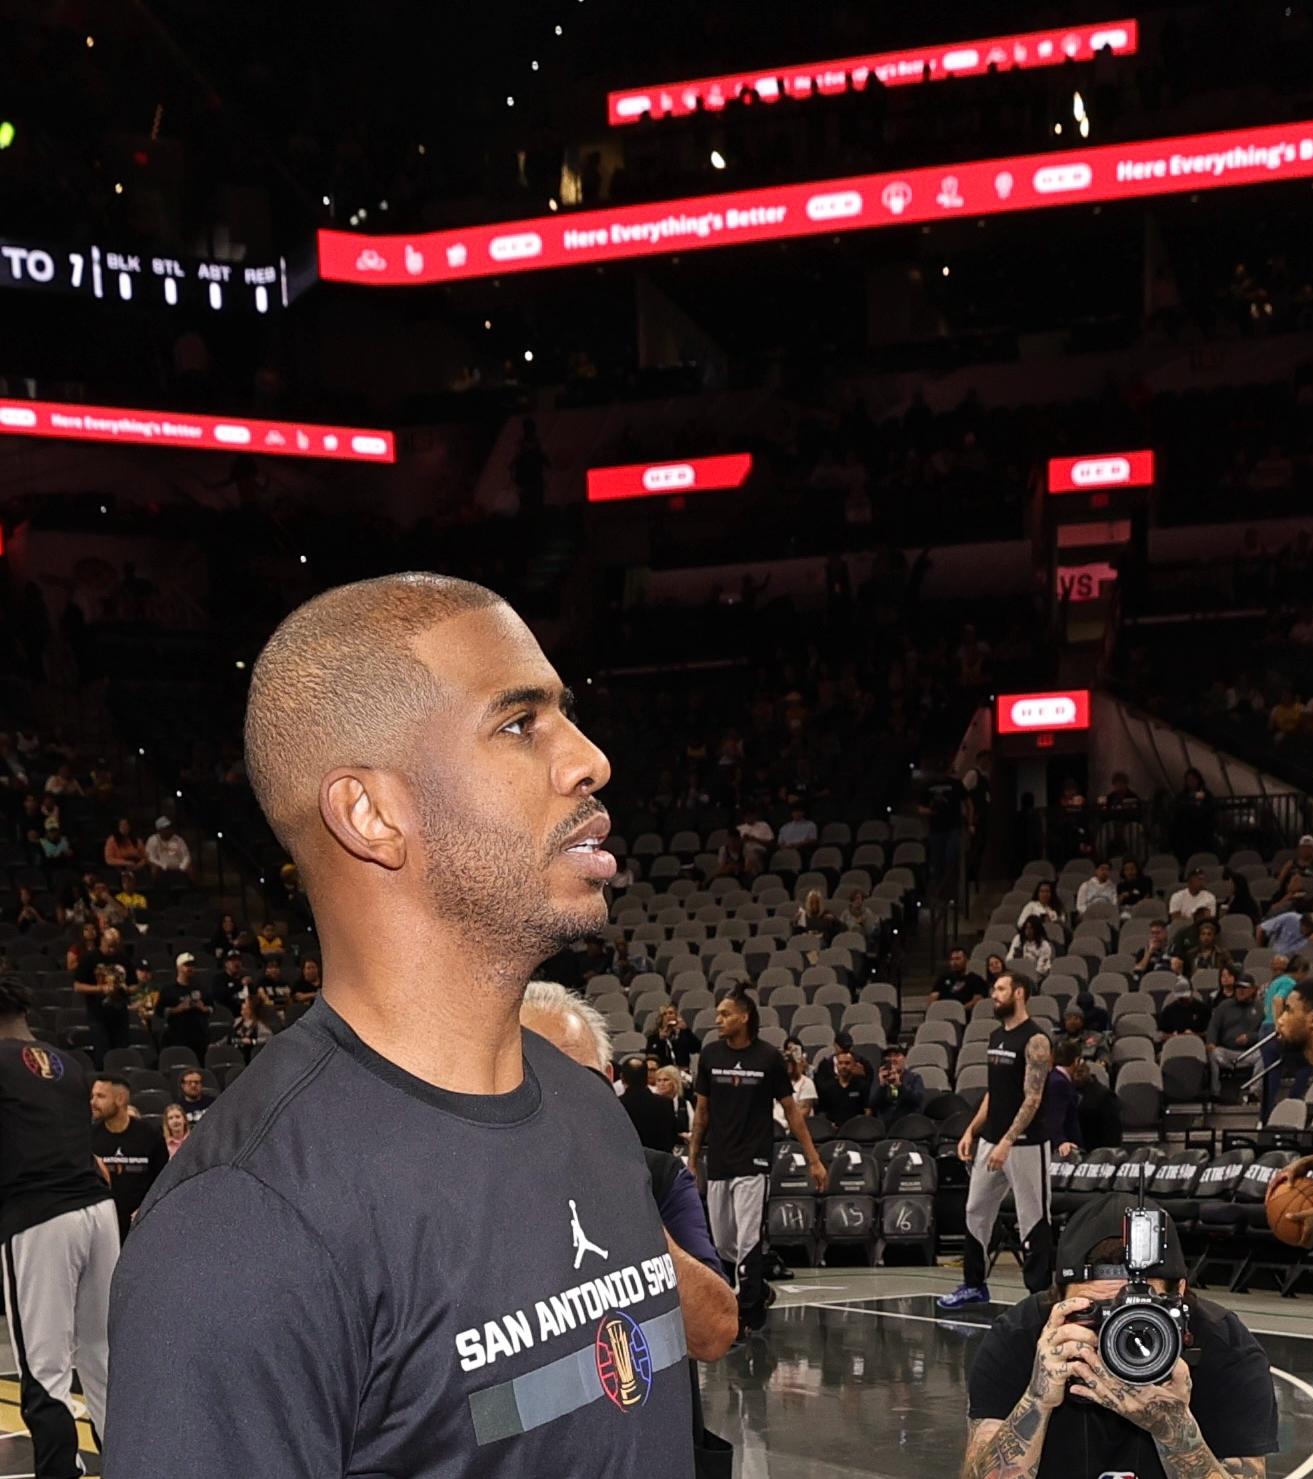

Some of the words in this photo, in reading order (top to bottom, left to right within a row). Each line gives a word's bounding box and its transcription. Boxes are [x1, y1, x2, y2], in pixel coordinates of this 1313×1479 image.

[1116, 159, 1166, 182] Here
[1169, 142, 1296, 176] Everything's
[563, 228, 608, 249] Here
[610, 212, 723, 243] Everything's
[725, 205, 787, 230] Better
[1, 246, 55, 282] TO
[106, 252, 142, 273] BLK
[152, 258, 186, 278] STL
[198, 263, 233, 282] AST
[244, 267, 277, 285] REB
[896, 1207, 912, 1230] 16
[455, 1310, 534, 1372] SAN
[535, 1265, 645, 1342] ANTONIO
[1126, 1296, 1152, 1305] Nikon
